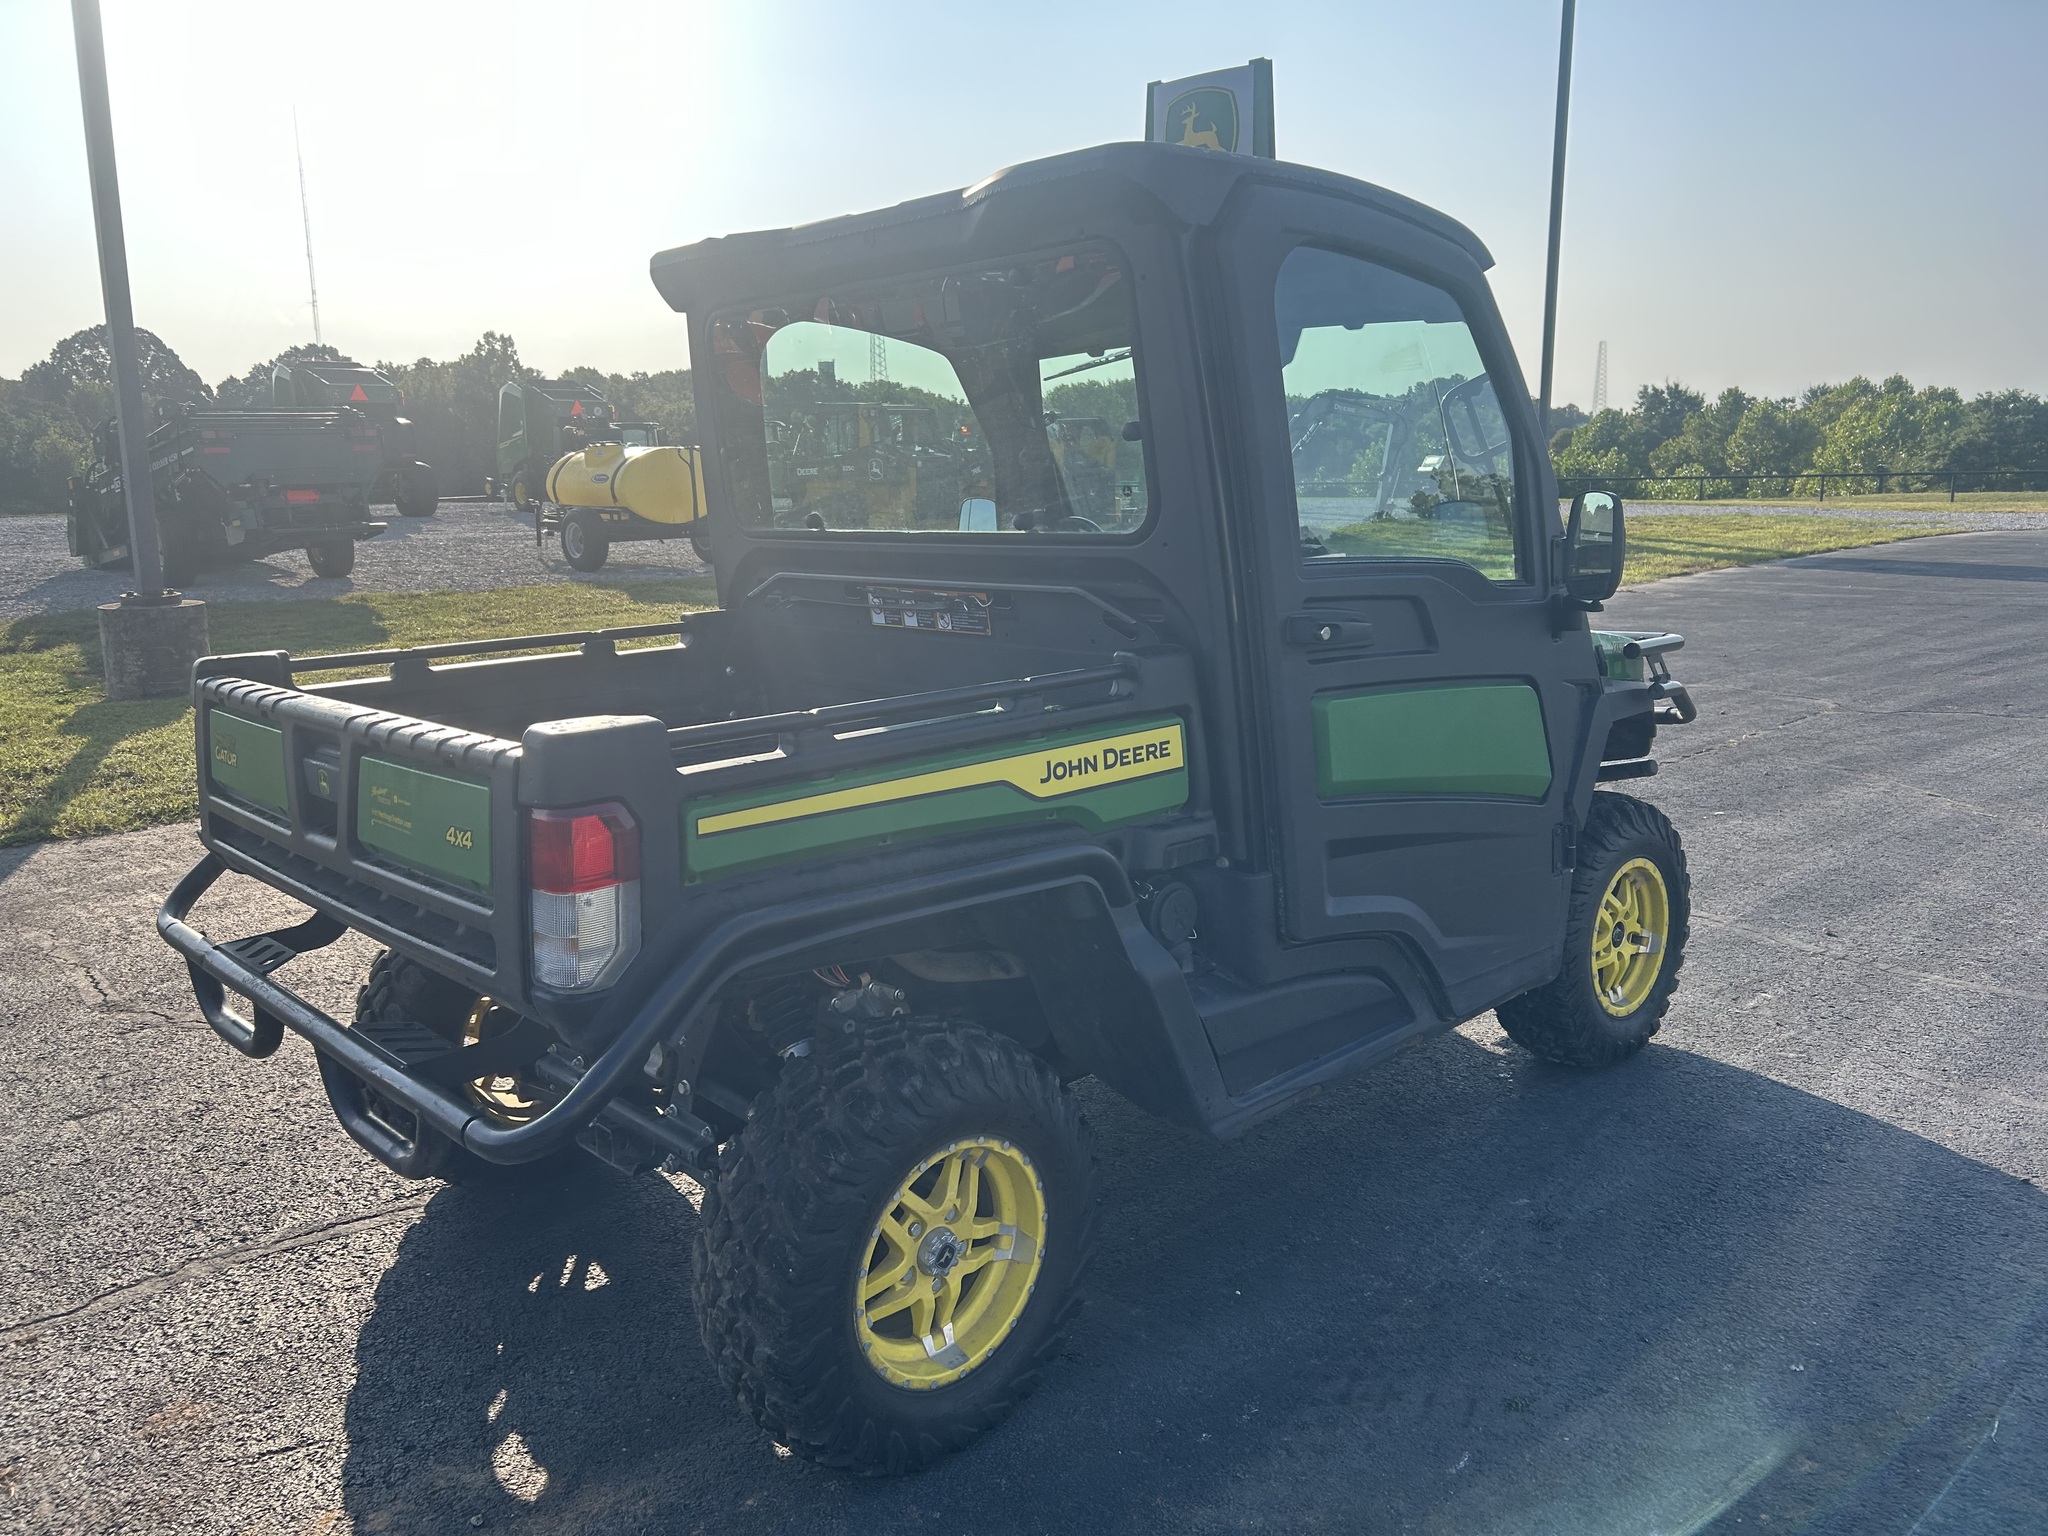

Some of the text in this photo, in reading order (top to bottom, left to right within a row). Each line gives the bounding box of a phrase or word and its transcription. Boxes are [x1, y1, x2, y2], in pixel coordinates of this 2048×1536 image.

[215, 745, 237, 767] GATOR
[1040, 740, 1171, 784] JOHN DEERE
